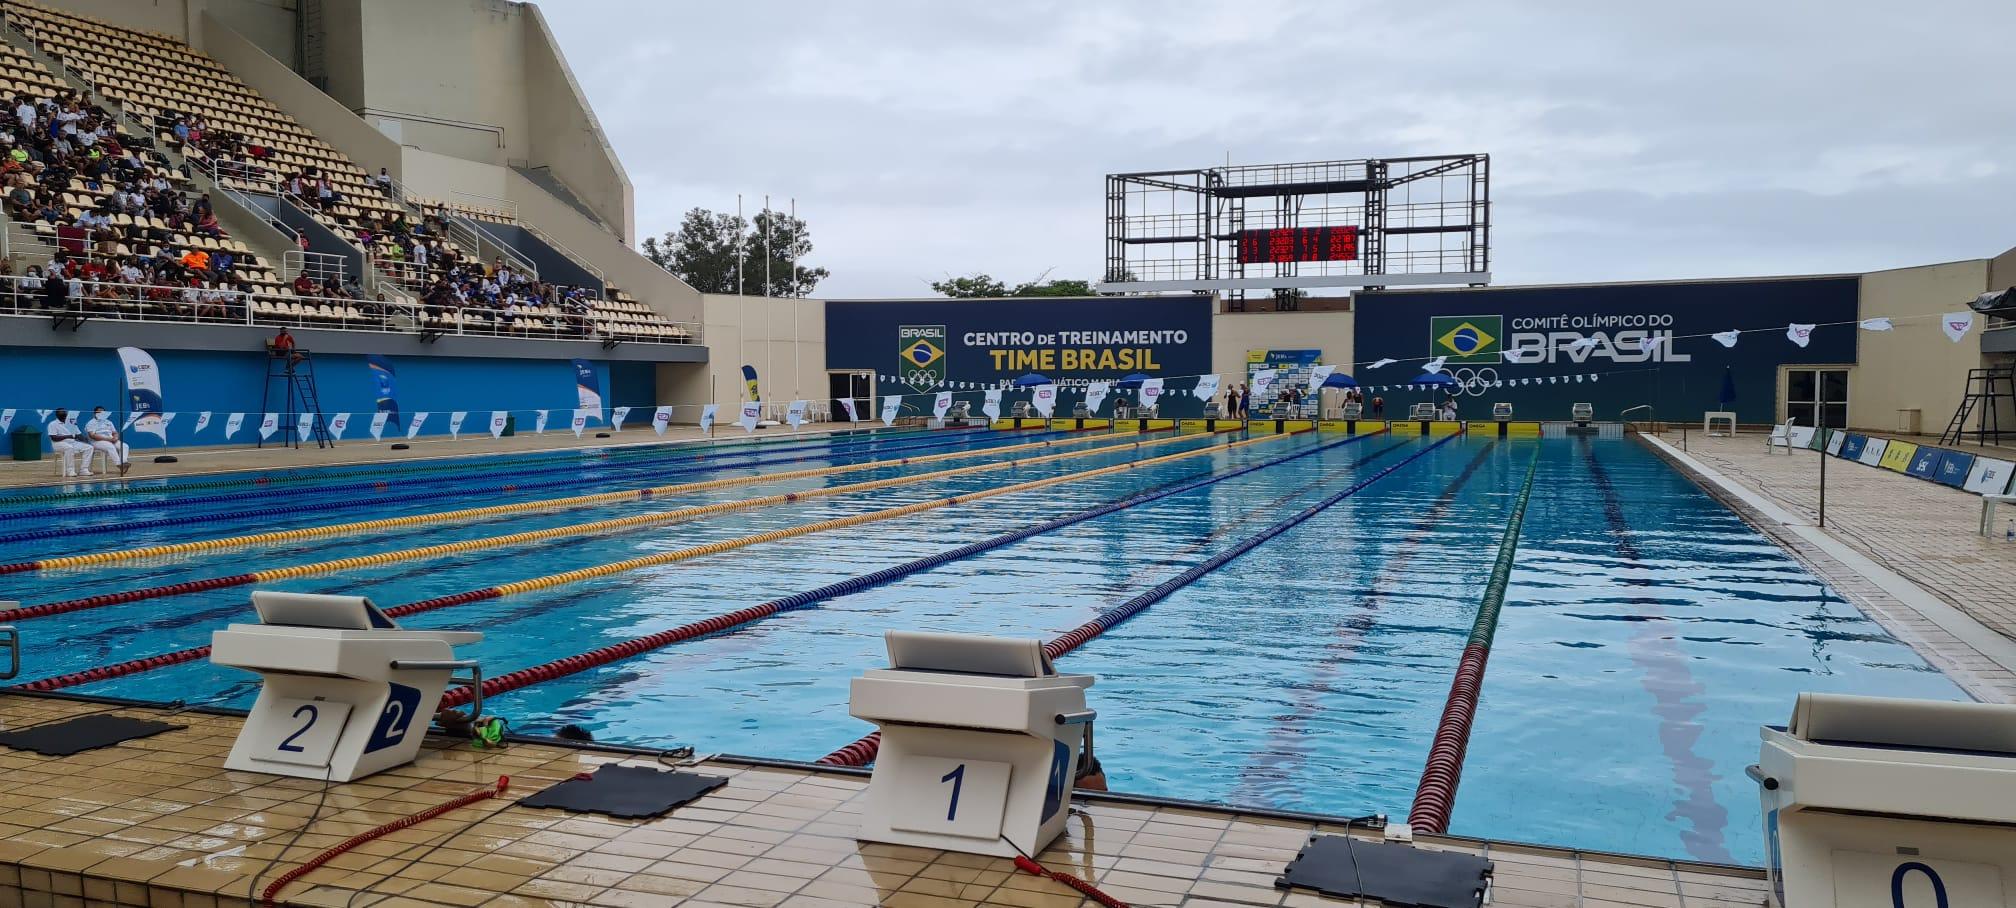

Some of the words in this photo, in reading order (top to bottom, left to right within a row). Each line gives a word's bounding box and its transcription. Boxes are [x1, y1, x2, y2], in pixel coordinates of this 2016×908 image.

[901, 328, 944, 338] BRASIL
[963, 331, 1035, 346] CENTRO
[1059, 330, 1188, 345] TREINAMENTO
[1512, 314, 1569, 329] COMITÊ
[1572, 313, 1646, 328] OLÍMPICO
[1649, 314, 1673, 326] DO
[990, 349, 1056, 370] TIME
[1061, 348, 1161, 370] BRASIL
[1511, 330, 1691, 364] BRASIL
[277, 704, 318, 753] 2
[386, 700, 404, 739] 2
[941, 764, 965, 821] 1
[1054, 760, 1060, 801] 1
[1891, 862, 1949, 908] 0
